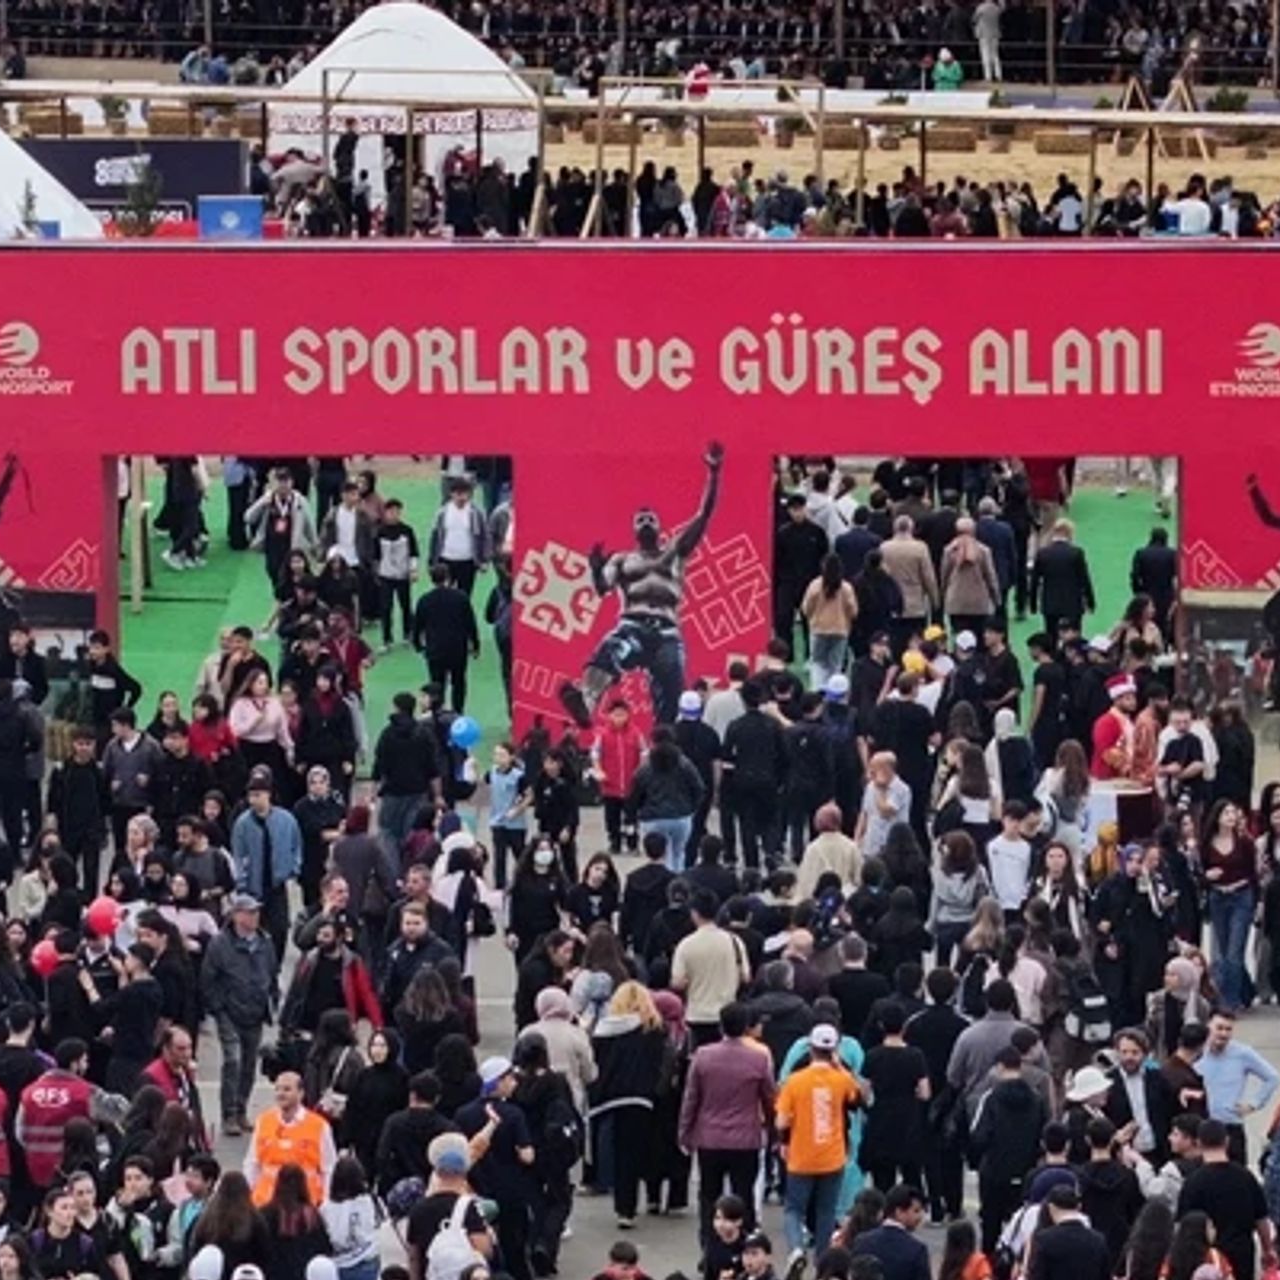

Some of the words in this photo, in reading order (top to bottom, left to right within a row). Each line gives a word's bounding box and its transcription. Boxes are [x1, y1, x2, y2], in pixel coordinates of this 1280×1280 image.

[121, 327, 257, 394] ATLI
[283, 327, 590, 395] SPORLAR
[616, 337, 695, 391] ve
[720, 312, 943, 406] GÜREŞ
[969, 328, 1163, 395] ALANI
